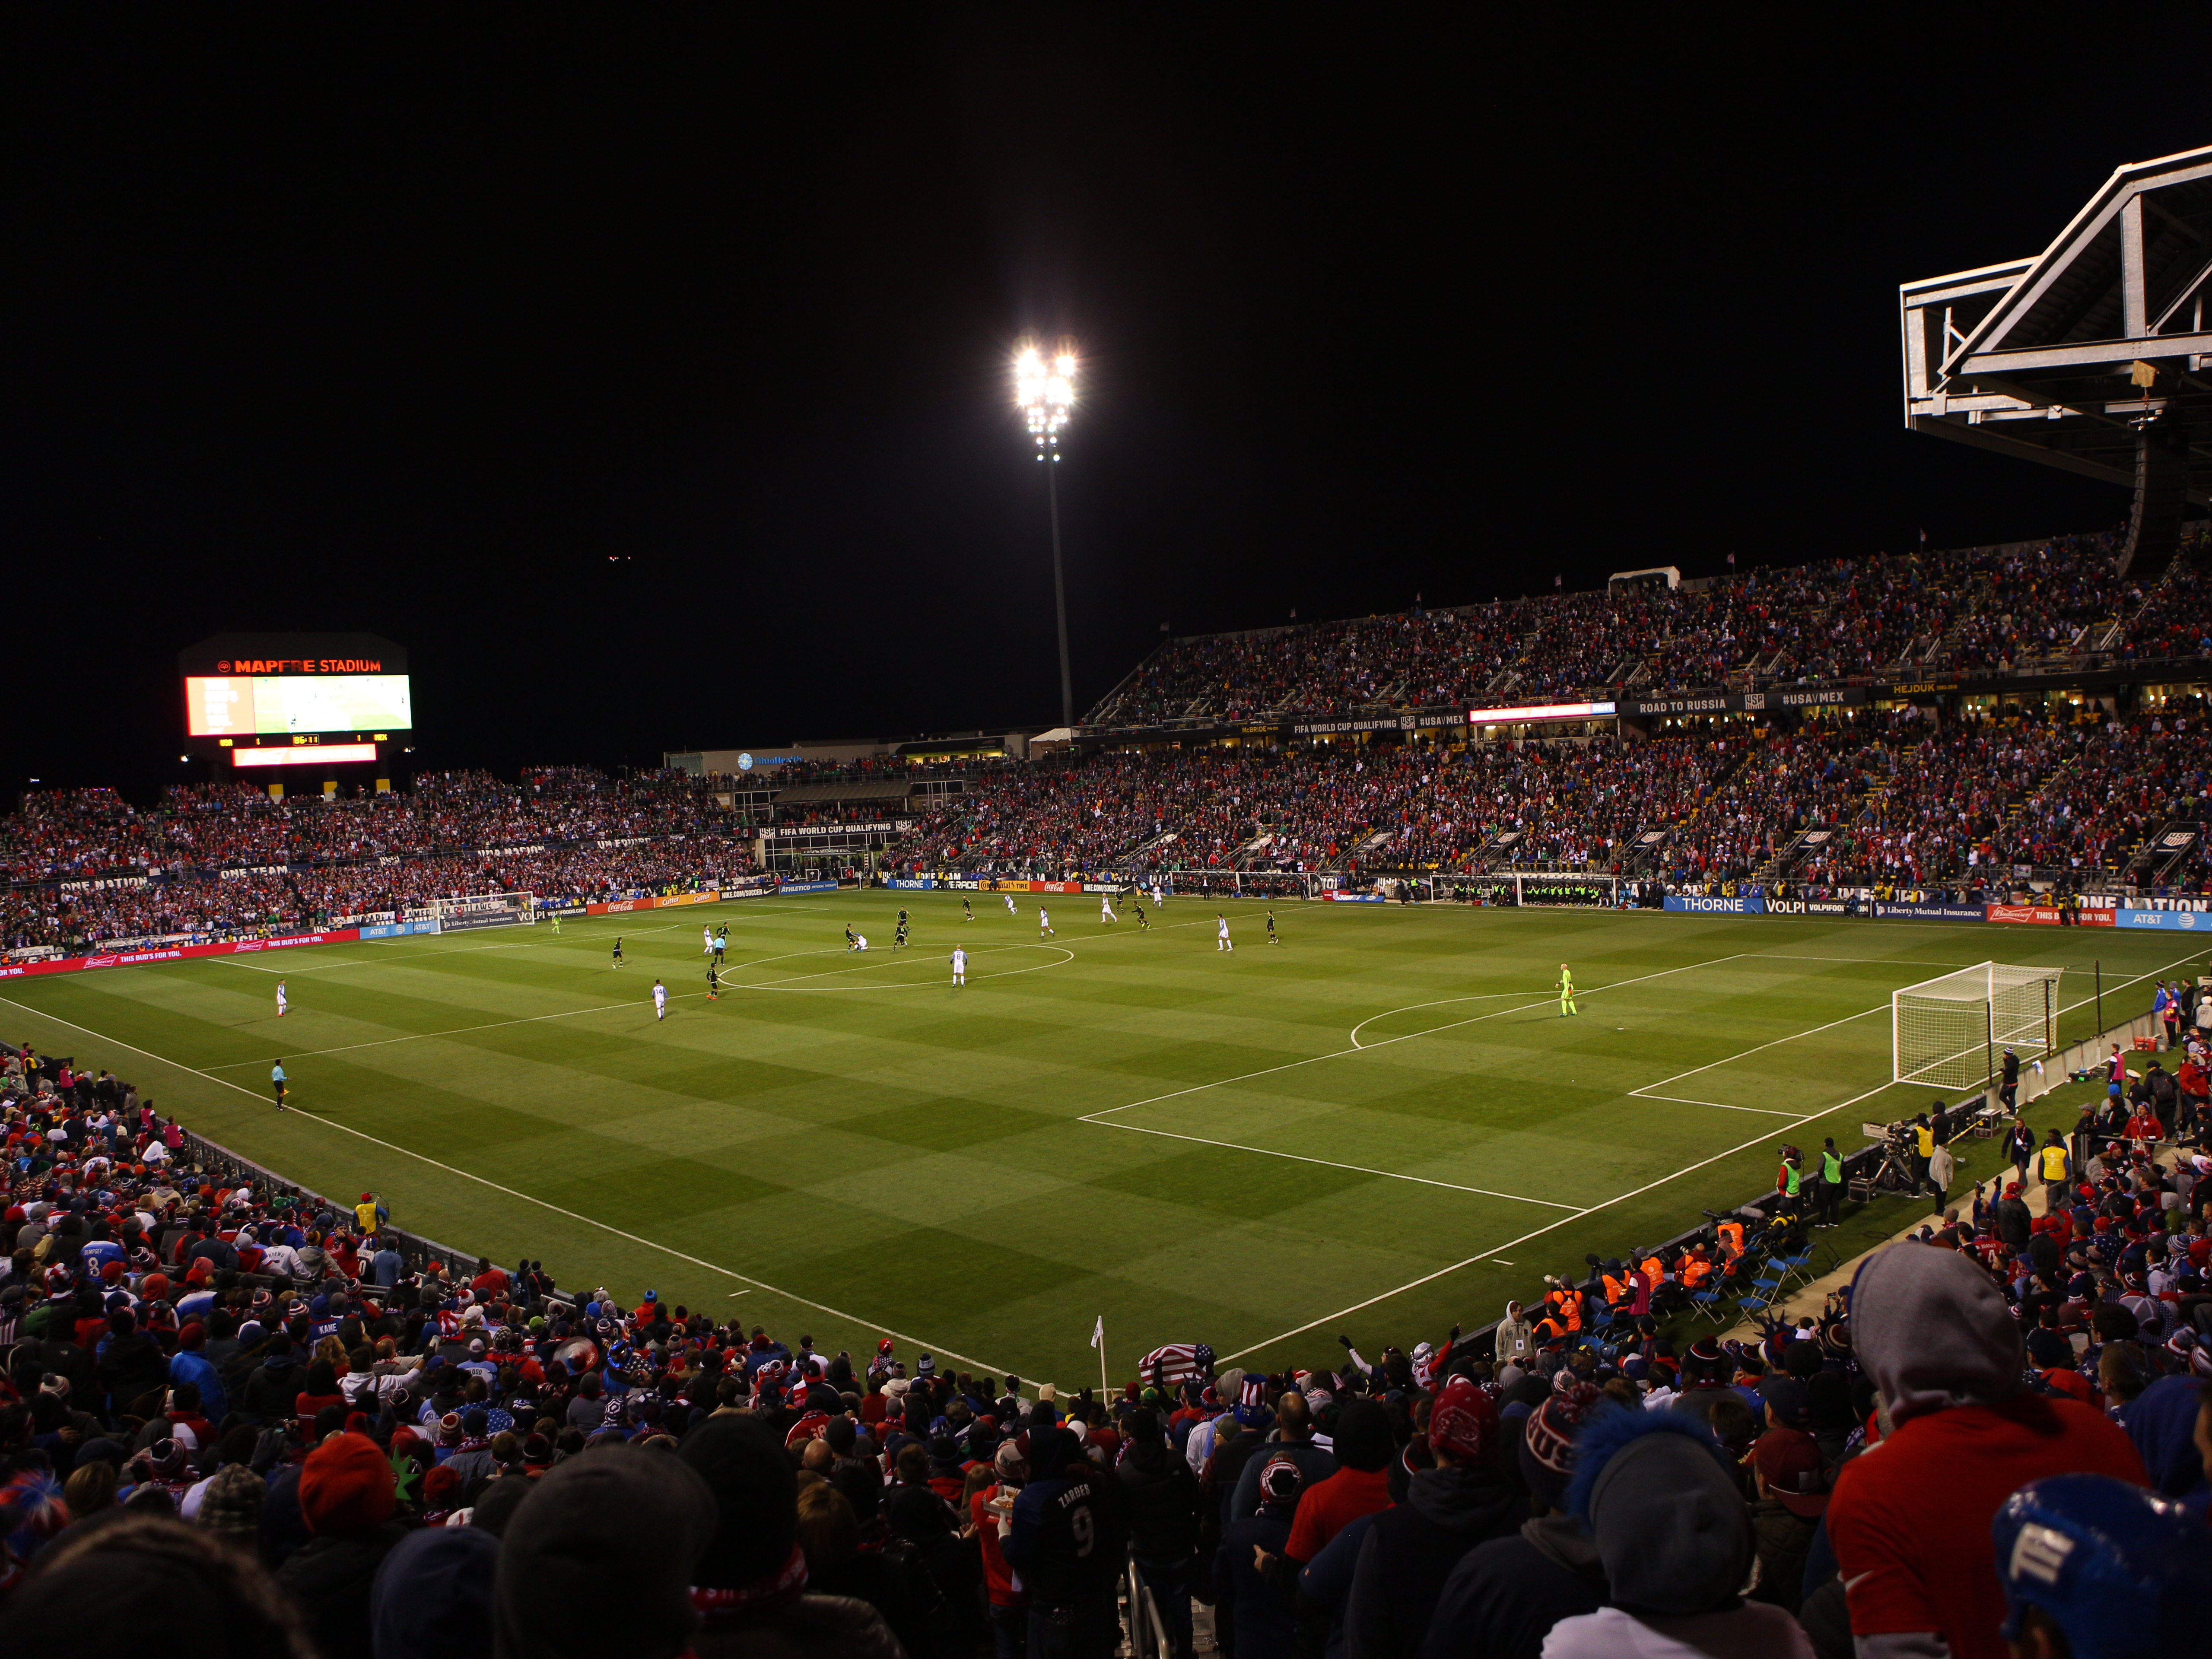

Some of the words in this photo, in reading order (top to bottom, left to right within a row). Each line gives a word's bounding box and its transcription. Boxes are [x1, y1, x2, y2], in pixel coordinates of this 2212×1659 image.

[235, 660, 315, 673] MAPFRE
[320, 659, 381, 672] STADIUM
[1894, 684, 1935, 694] HEJDUK
[1640, 702, 1667, 713] ROAD
[1670, 701, 1684, 712] TO
[1687, 699, 1726, 710] RUSSIA
[1294, 725, 1309, 733] FIFA
[1310, 724, 1334, 732] WORLD
[1338, 723, 1352, 731] CUP
[1354, 719, 1396, 731] QUALIFYING
[293, 736, 318, 744] 86:11
[845, 823, 891, 832] QUALIFYING
[221, 868, 247, 879] ONE
[251, 865, 288, 875] TEAM
[60, 881, 89, 891] ONE
[95, 877, 148, 890] NATION
[781, 885, 810, 893] ATHLETICO
[896, 880, 923, 888] THORNE
[693, 893, 711, 903] Cutter
[721, 888, 763, 899] NIKE.COM/SOCCER
[662, 896, 680, 906] Cutter
[1682, 898, 1744, 911] THORNE
[1765, 899, 1805, 914] VOLPI
[1888, 907, 1913, 917] Liberty
[1944, 909, 1981, 917] Insurance
[1993, 909, 2031, 918] Budweiser
[2133, 914, 2163, 924] AT&T
[87, 958, 114, 966] Budweiser
[10, 967, 25, 976] YOU.
[88, 1256, 100, 1277] 8
[319, 1323, 337, 1334] KANE
[1058, 1483, 1090, 1509] ZARDES
[1072, 1506, 1094, 1558] 9
